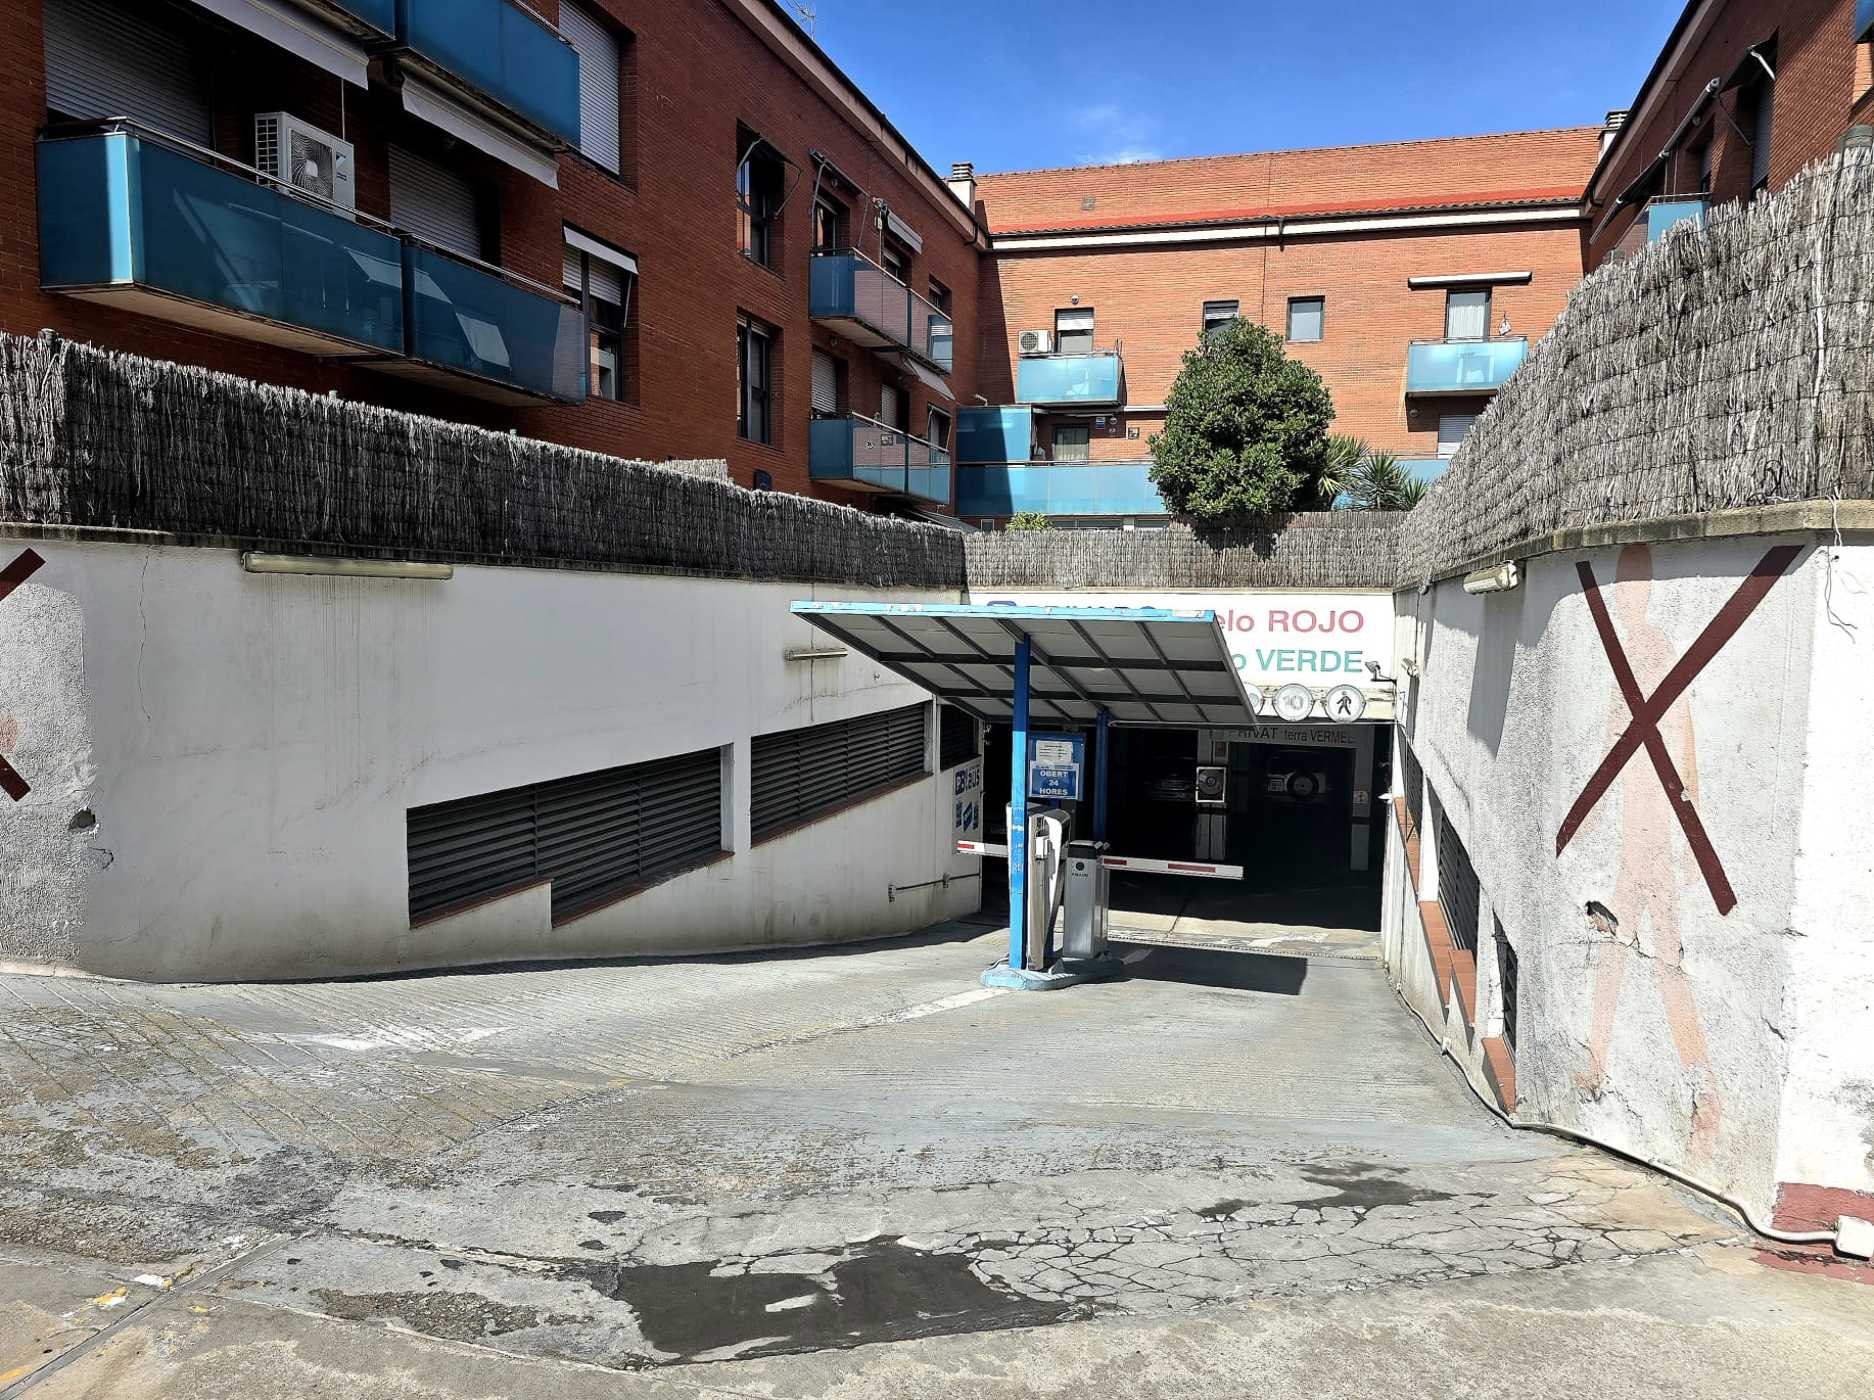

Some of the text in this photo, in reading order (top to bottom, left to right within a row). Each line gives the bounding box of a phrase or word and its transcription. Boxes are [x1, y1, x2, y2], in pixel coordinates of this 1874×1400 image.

[1268, 609, 1364, 633] ROJO
[1255, 648, 1363, 673] VERDE
[1284, 729, 1307, 742] terra
[1039, 787, 1069, 796] HORES
